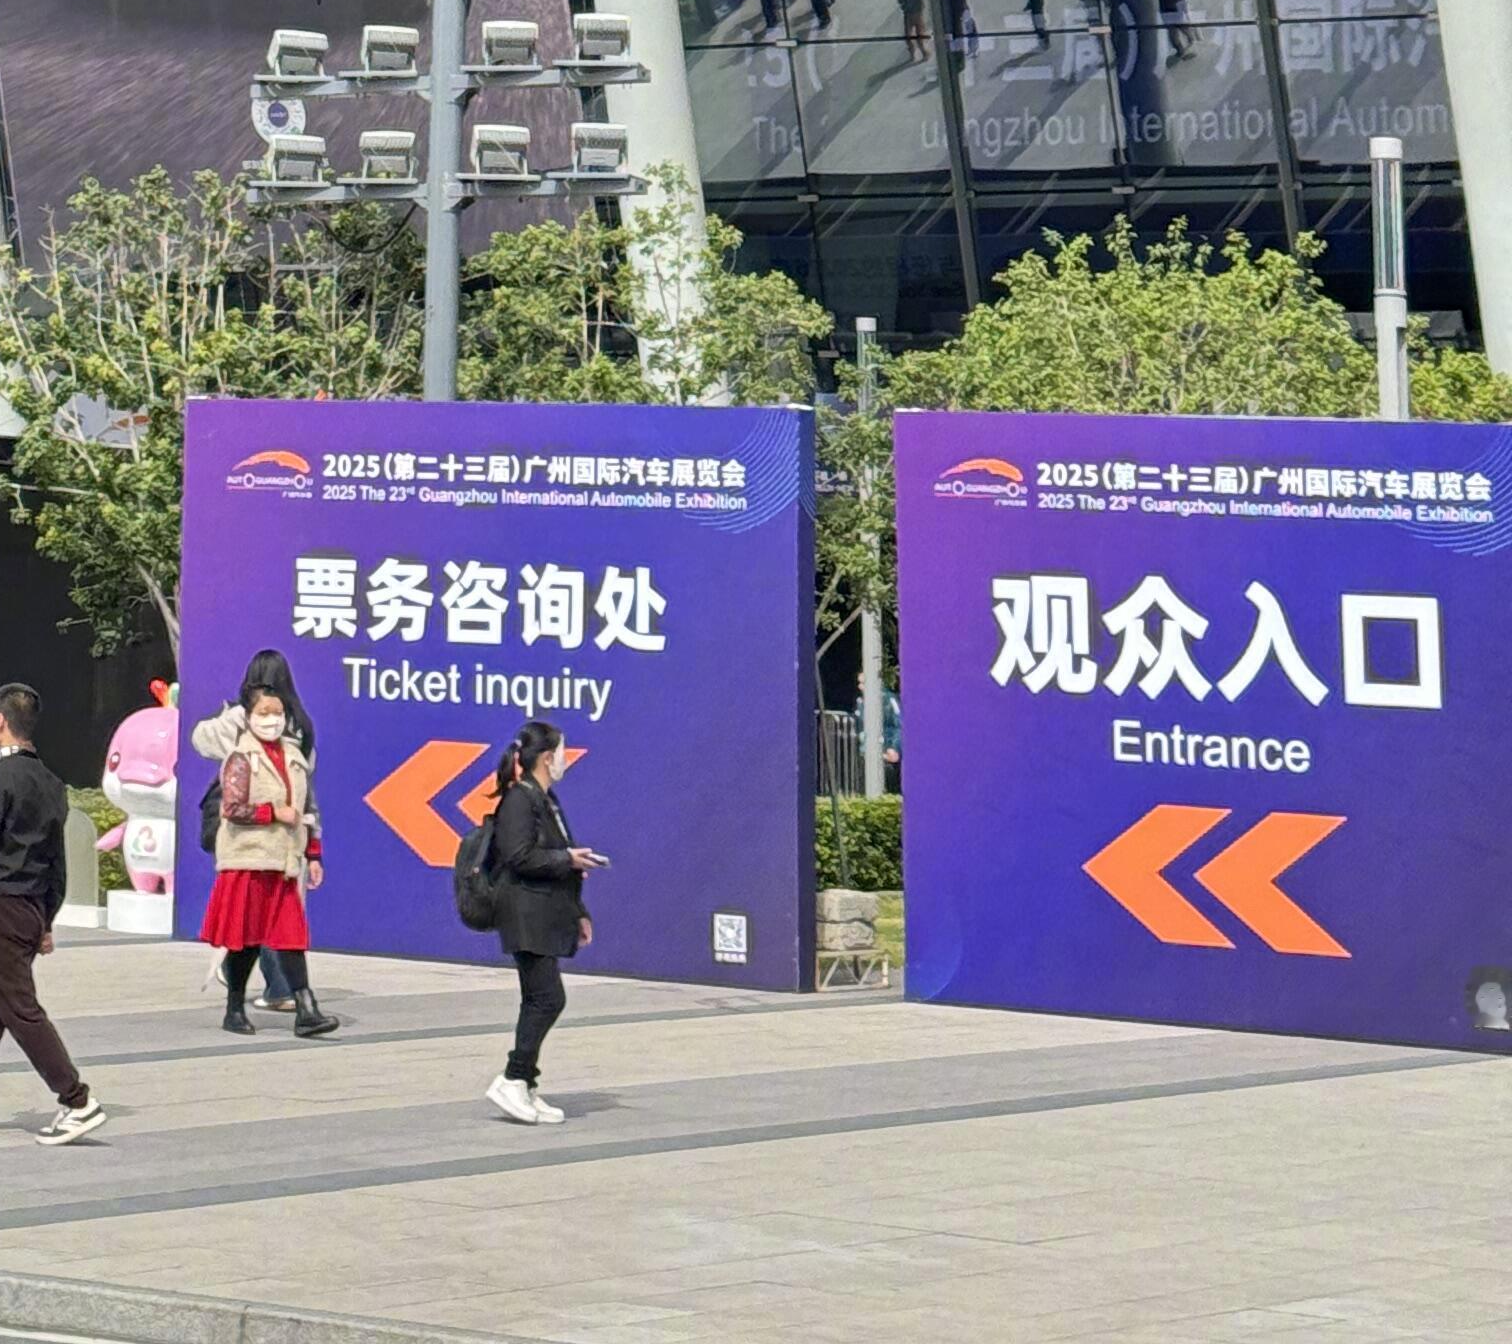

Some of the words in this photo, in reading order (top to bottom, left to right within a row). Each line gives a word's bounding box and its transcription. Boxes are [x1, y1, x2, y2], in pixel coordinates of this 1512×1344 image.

[322, 485, 357, 502] 2025
[359, 485, 386, 502] The
[389, 485, 416, 503] 23rd
[419, 486, 498, 508] Guangzhou
[501, 488, 588, 507] International
[591, 489, 671, 509] Automobile
[675, 492, 748, 511] Exhibition
[1037, 494, 1075, 510] 2025
[1077, 494, 1106, 511] The
[1140, 496, 1227, 518] Guangzhou
[1230, 498, 1323, 519] International
[1326, 502, 1412, 521] Automobile
[1416, 505, 1494, 524] Exhibition
[292, 557, 668, 651] 票务咨询处
[990, 574, 1443, 710] 观众入口
[343, 658, 461, 704] Ticket
[475, 665, 612, 722] inquiry
[1112, 719, 1311, 774] Entrance
